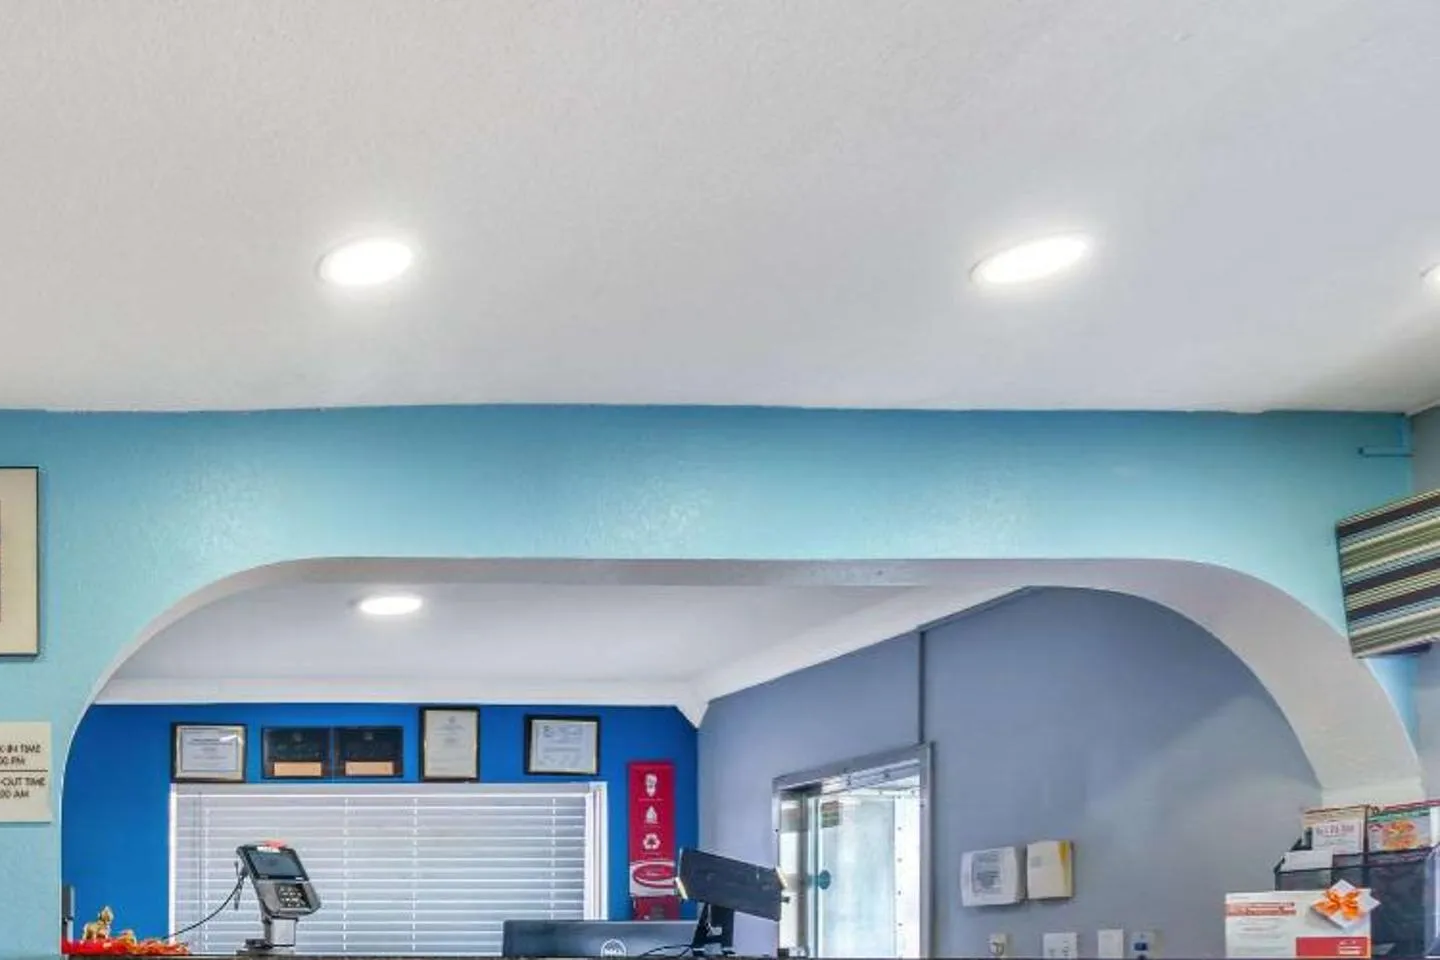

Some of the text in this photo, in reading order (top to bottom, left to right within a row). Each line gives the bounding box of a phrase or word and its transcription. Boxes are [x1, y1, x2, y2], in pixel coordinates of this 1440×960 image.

[20, 744, 41, 753] TIME
[11, 756, 26, 765] PM
[25, 777, 46, 787] TIME
[13, 789, 30, 799] AM
